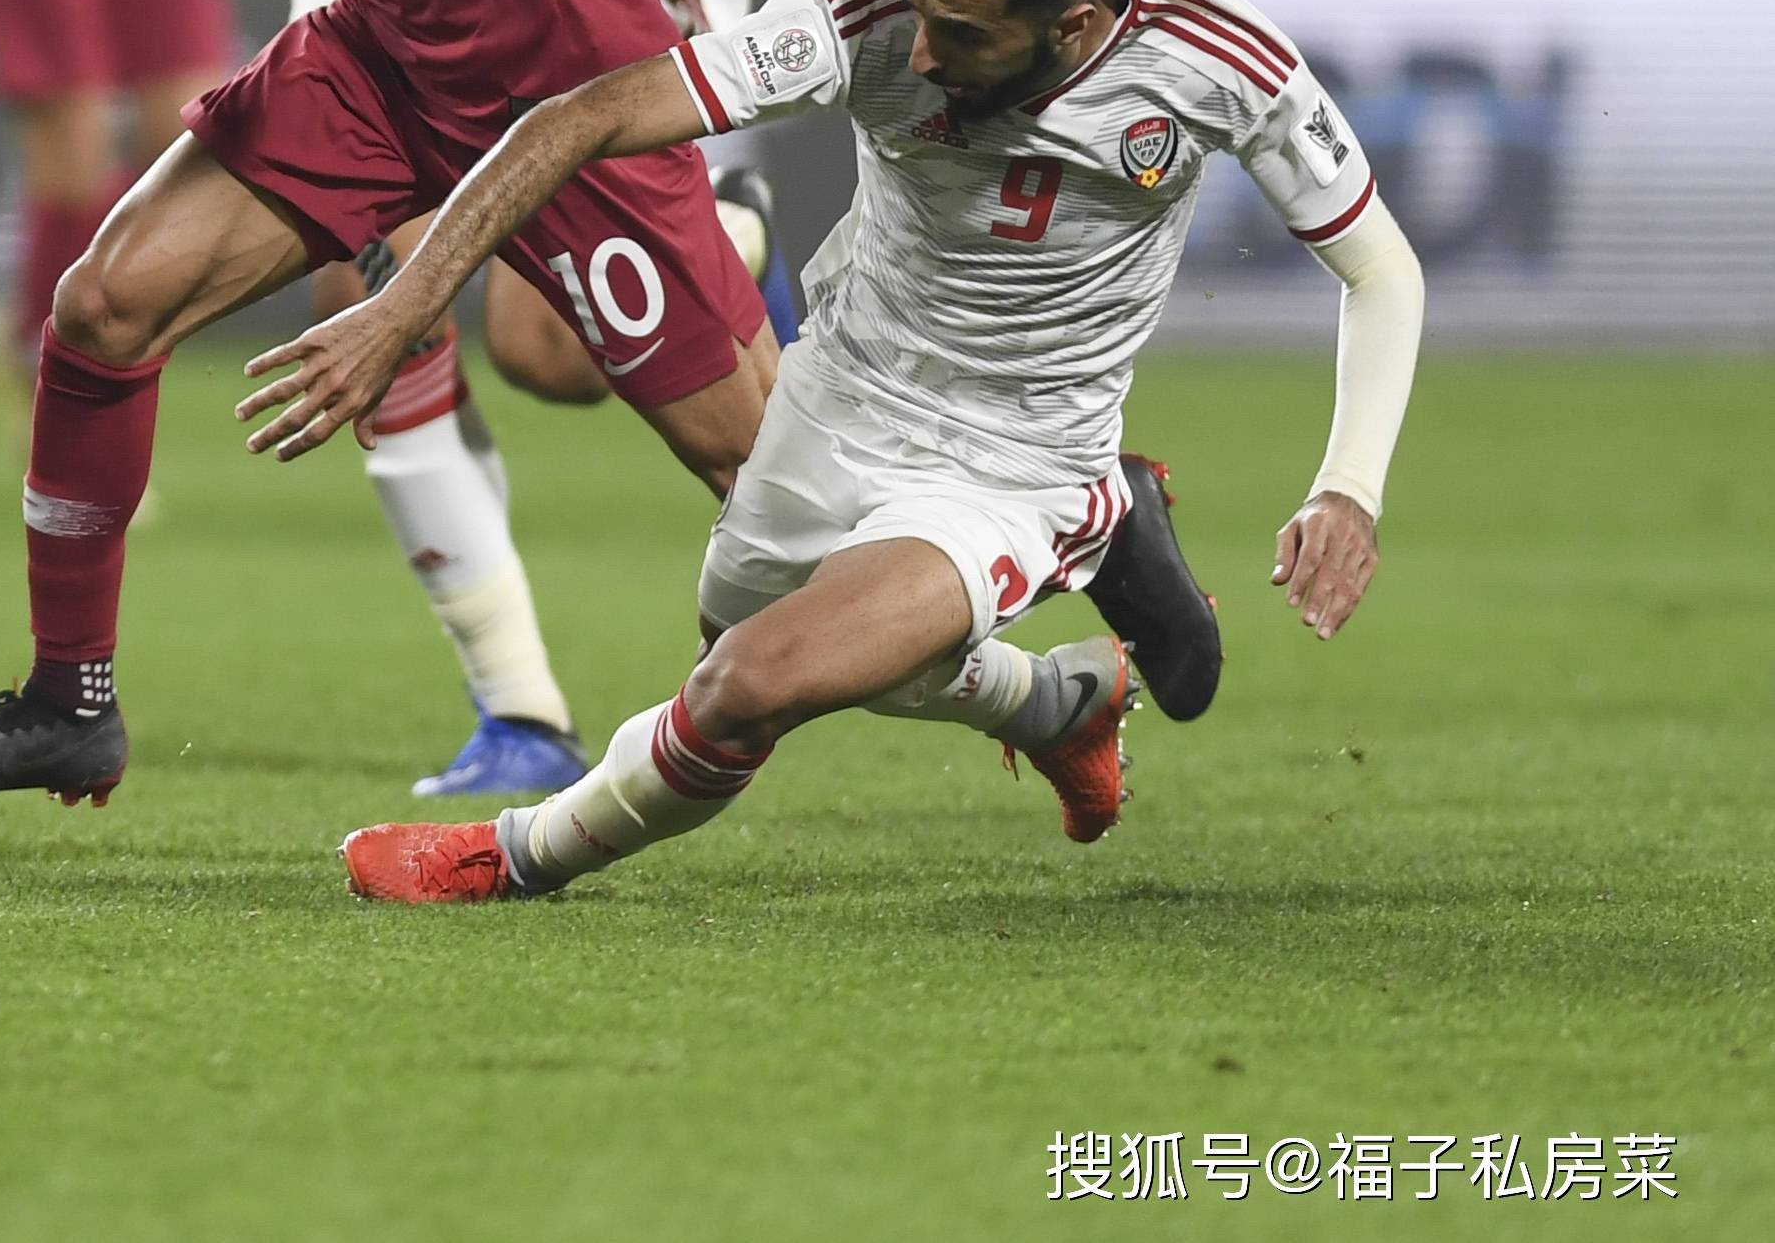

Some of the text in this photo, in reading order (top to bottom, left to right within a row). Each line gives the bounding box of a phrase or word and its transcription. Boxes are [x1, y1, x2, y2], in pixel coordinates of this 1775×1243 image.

[745, 36, 777, 95] ASIAN CUP
[762, 51, 776, 70] AFC
[911, 121, 970, 150] adidas
[1133, 136, 1162, 151] UAE
[1140, 148, 1156, 158] FA
[989, 156, 1063, 244] 9
[546, 236, 666, 347] 10
